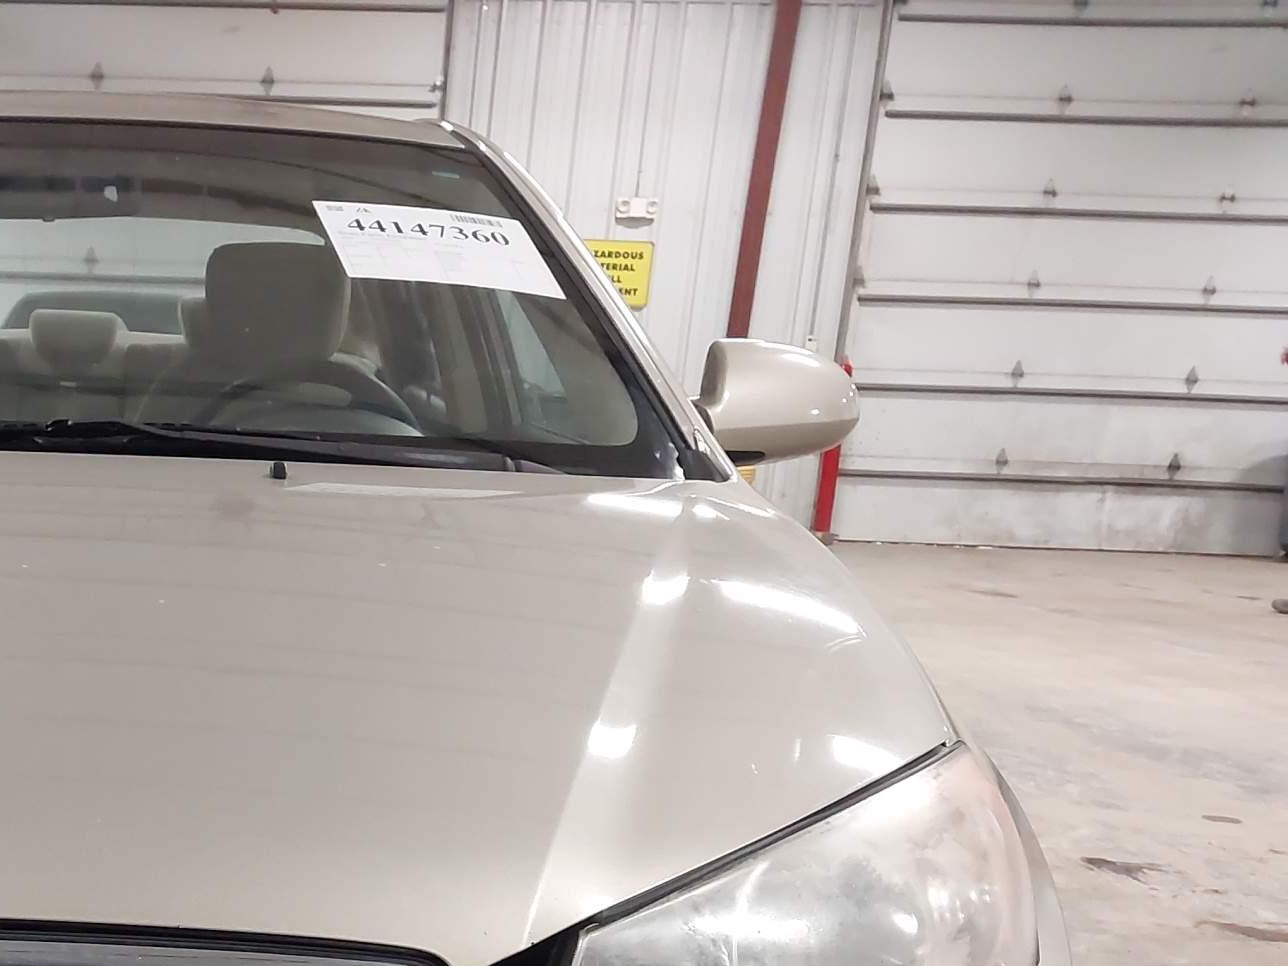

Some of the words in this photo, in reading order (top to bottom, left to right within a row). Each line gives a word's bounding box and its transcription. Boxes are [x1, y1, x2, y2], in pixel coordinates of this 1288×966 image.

[347, 218, 510, 246] 44147360
[593, 250, 644, 260] ZARDOUS
[600, 262, 636, 272] TERIAL
